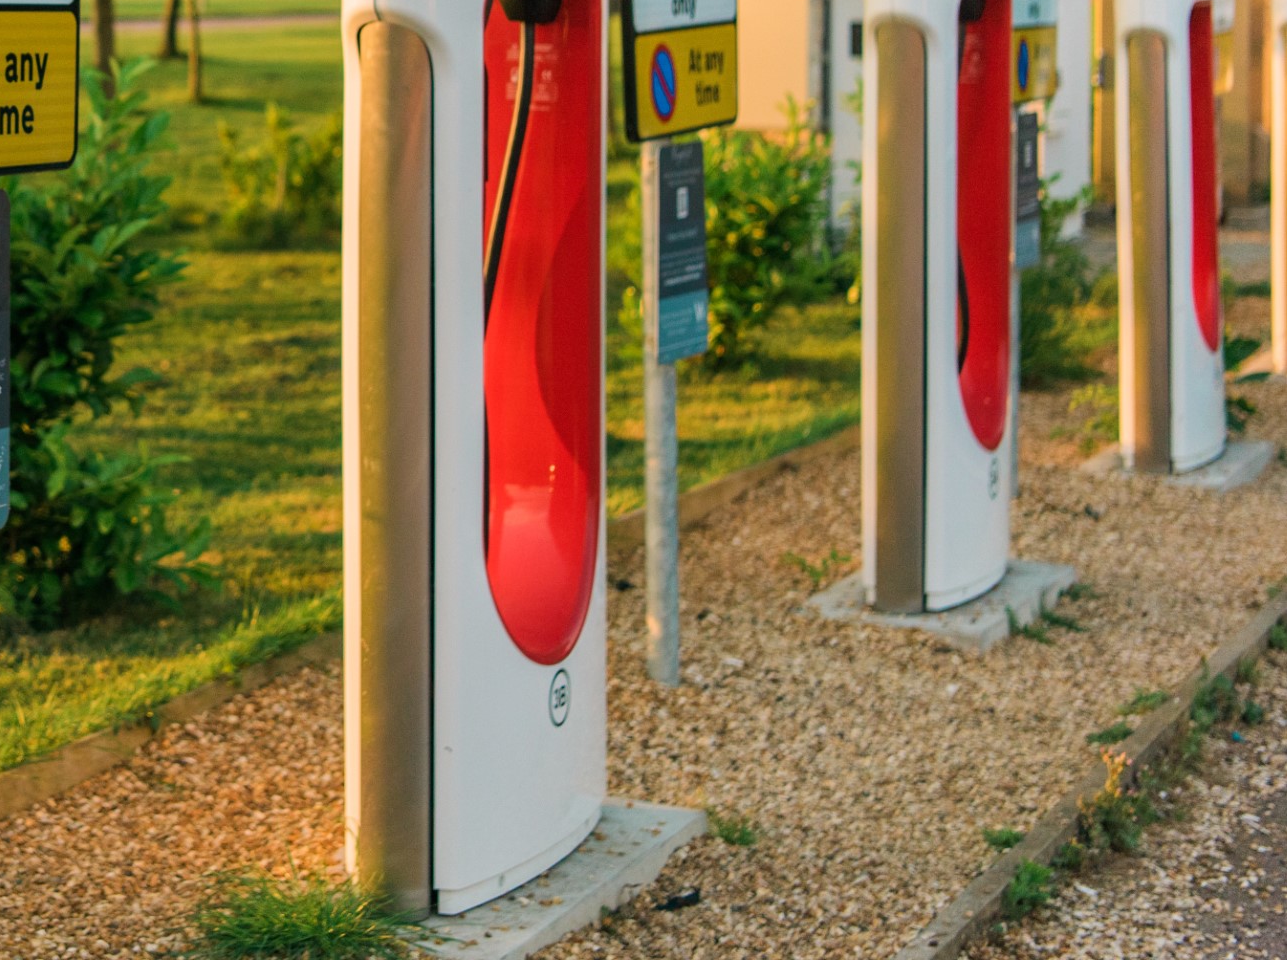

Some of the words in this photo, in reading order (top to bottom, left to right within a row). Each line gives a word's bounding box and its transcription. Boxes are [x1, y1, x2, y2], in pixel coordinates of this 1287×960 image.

[4, 52, 49, 90] any
[689, 48, 702, 74] At
[705, 51, 724, 75] any
[695, 80, 720, 106] time
